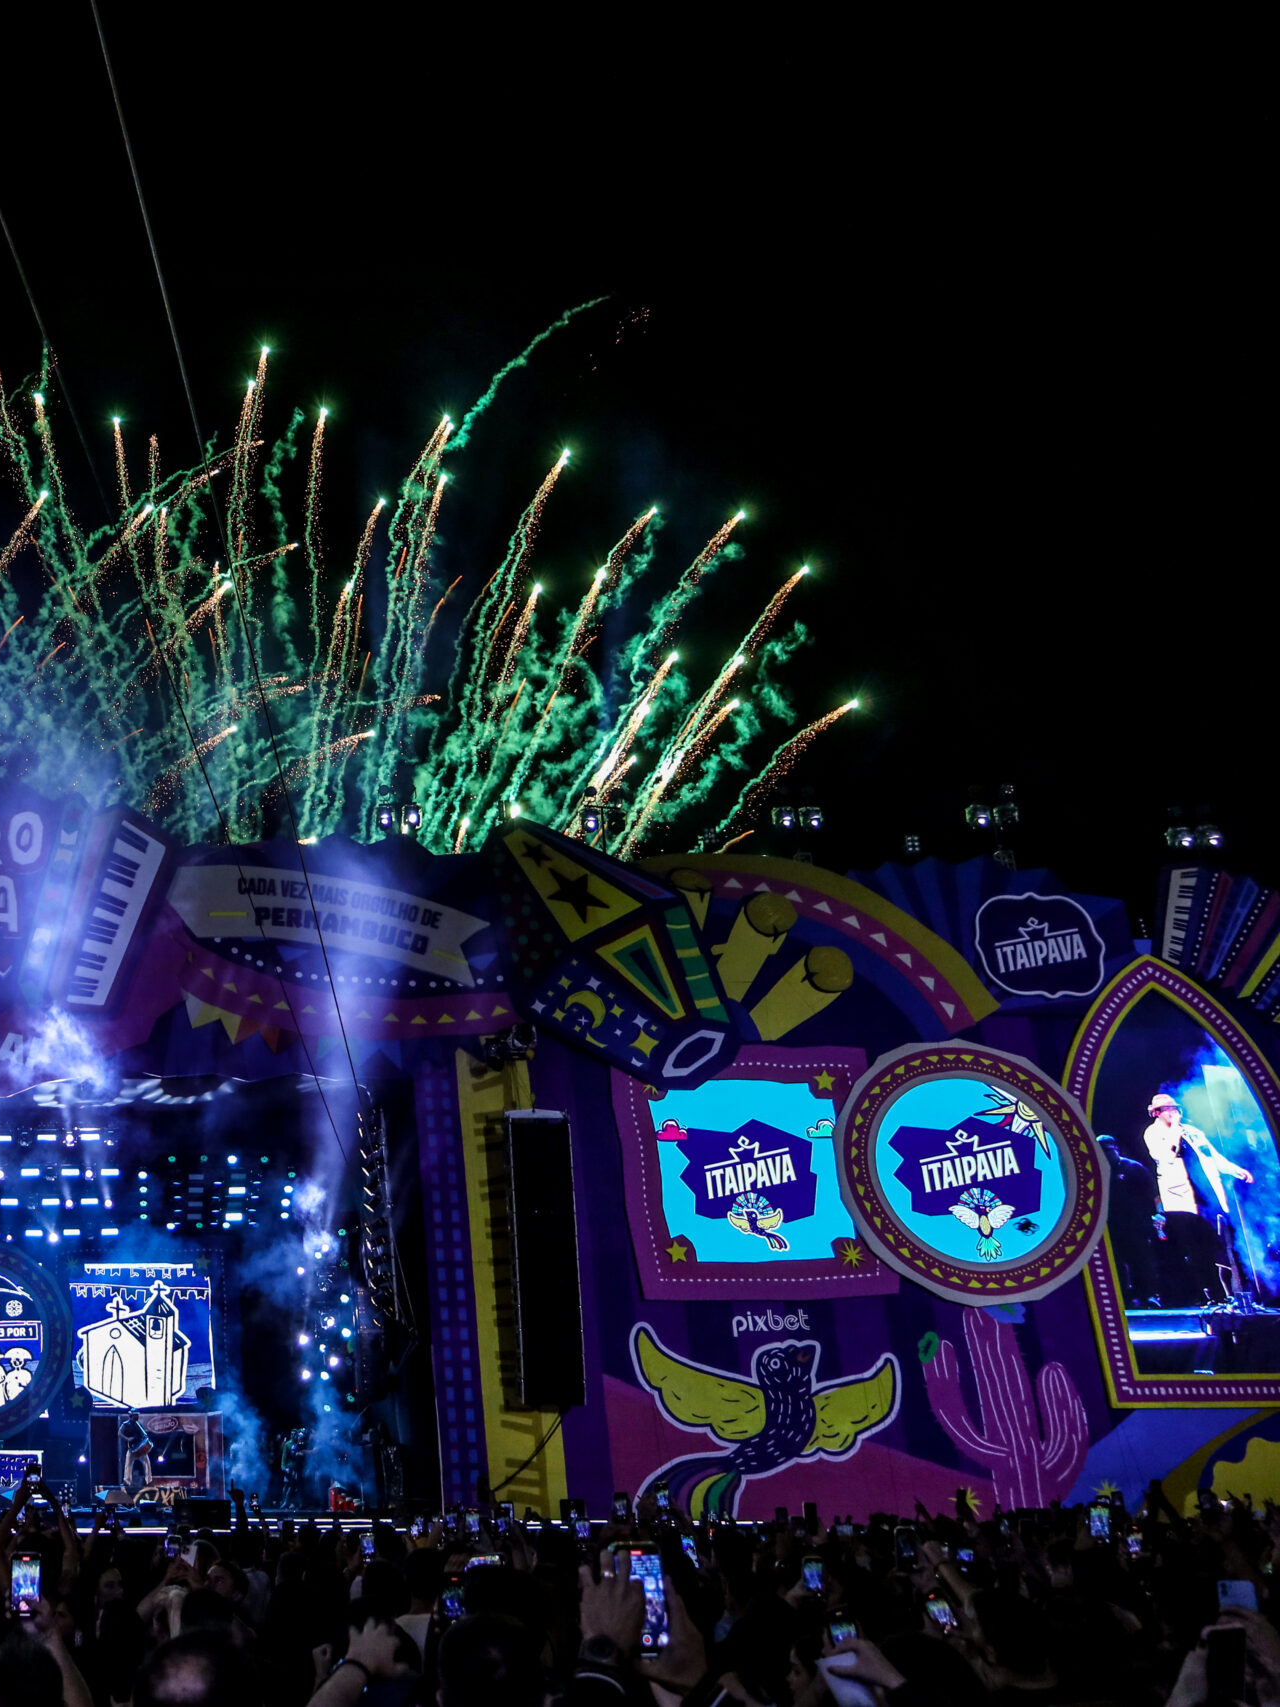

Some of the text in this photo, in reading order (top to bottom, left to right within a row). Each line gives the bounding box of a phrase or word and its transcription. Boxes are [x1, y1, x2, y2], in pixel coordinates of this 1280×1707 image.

[238, 877, 443, 930] CADA VEZ MAIS ORGULHO DE
[254, 906, 430, 956] PERNAMBUCO
[995, 933, 1088, 974] ITAIPAVA
[704, 1153, 797, 1200] ITAIPAVA
[920, 1146, 1021, 1193] ITAIPAVA
[6, 1326, 26, 1337] POR
[28, 1326, 33, 1337] 1
[732, 1308, 811, 1338] pixbet
